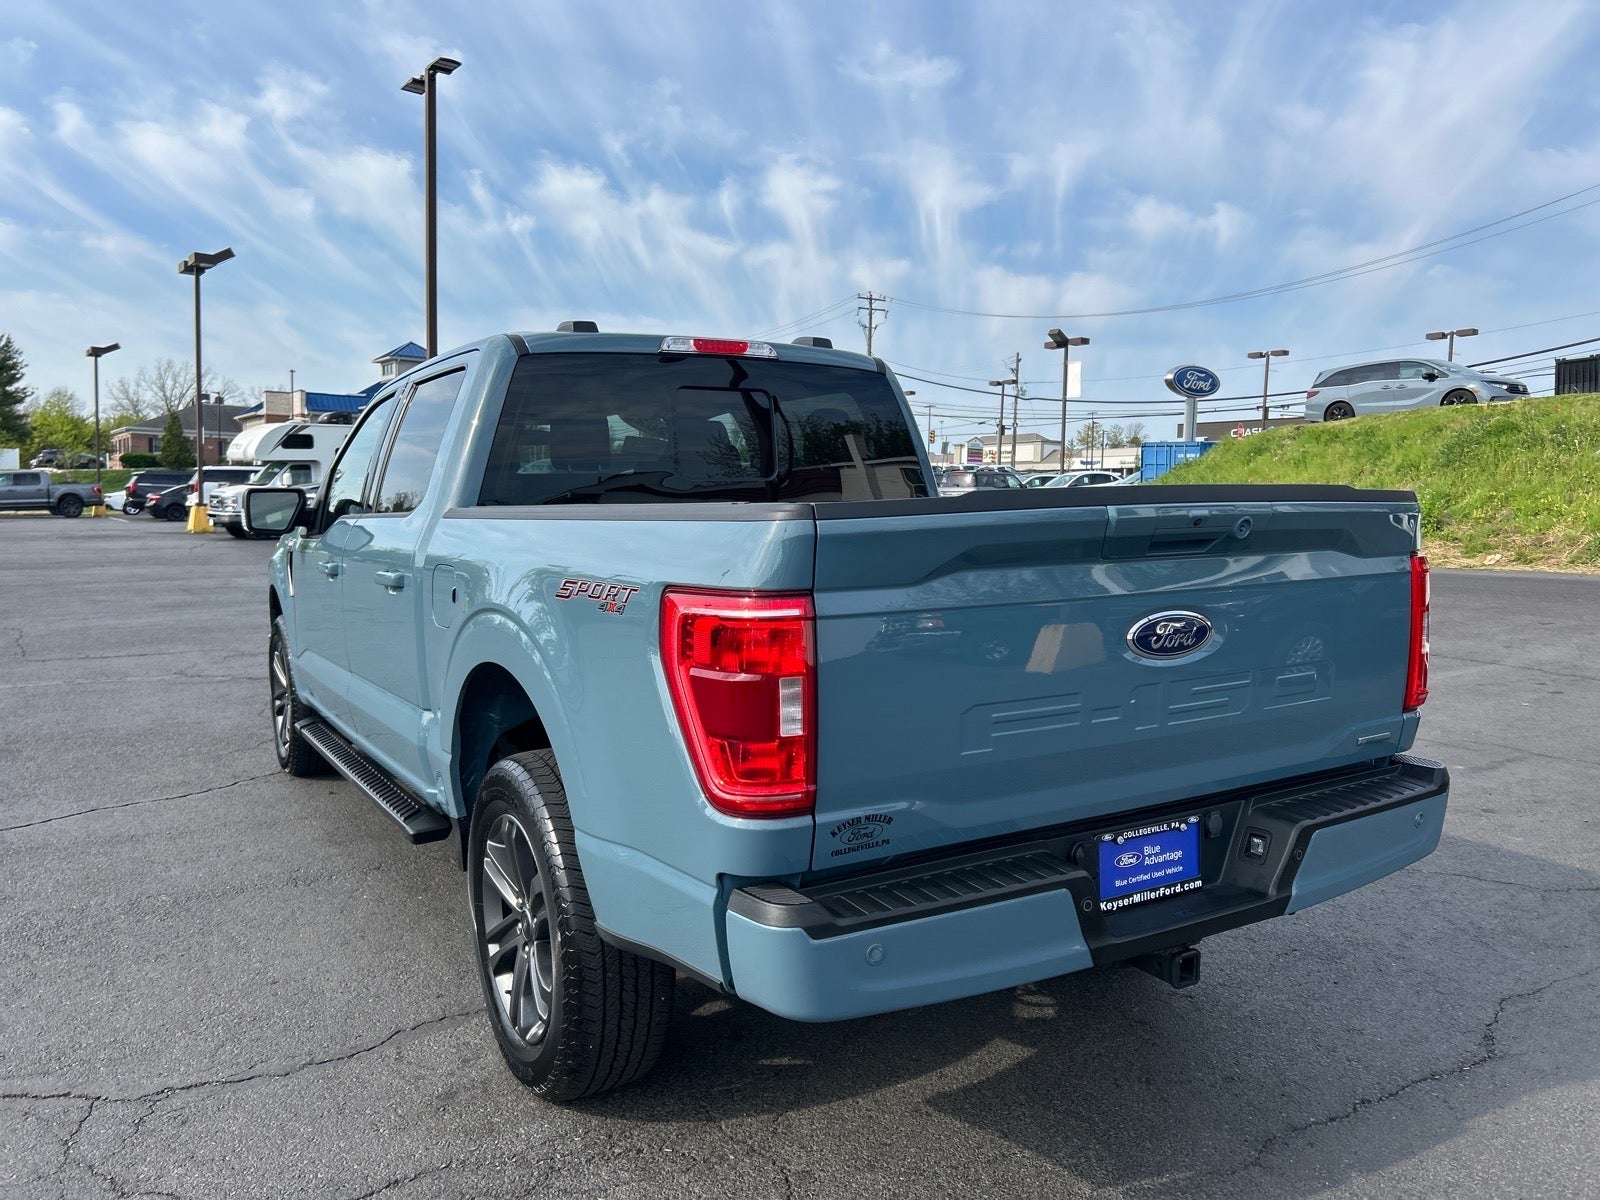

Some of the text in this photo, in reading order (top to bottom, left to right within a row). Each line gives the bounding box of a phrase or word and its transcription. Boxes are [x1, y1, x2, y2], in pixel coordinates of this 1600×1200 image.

[1183, 370, 1212, 391] Ford
[555, 578, 640, 604] SPORT
[1151, 621, 1197, 650] Ford
[830, 813, 894, 838] KEYSER MILLER
[847, 826, 876, 842] Ford
[1123, 824, 1169, 839] COLLEGEVILLE,
[1171, 821, 1180, 829] PA
[1143, 845, 1161, 855] Blue
[1144, 850, 1183, 866] Advantage
[1119, 855, 1138, 866] Ford
[1128, 872, 1151, 884] Certified
[1151, 869, 1165, 879] Used
[1165, 865, 1184, 876] Vehicle
[1100, 880, 1202, 911] KeyserMillerFord.com
